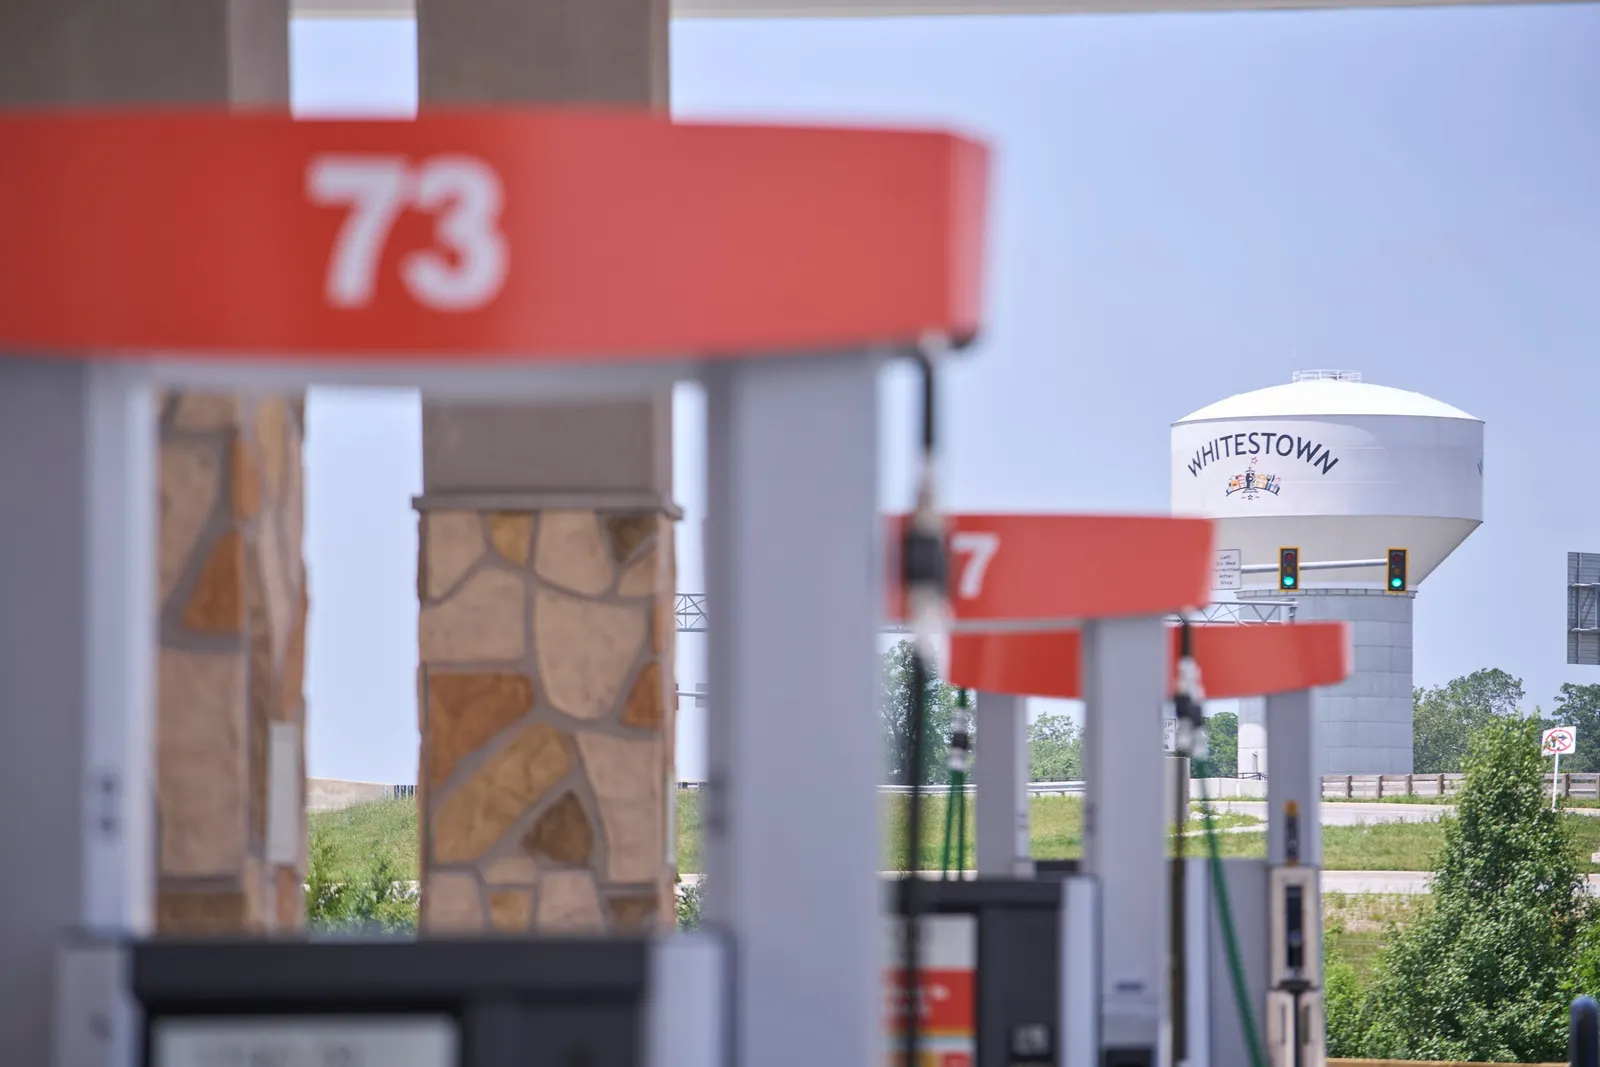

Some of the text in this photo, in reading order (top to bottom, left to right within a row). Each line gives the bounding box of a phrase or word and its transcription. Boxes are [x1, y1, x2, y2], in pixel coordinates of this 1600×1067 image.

[307, 153, 511, 310] 73
[1187, 431, 1339, 478] WHITESTOWN
[951, 531, 1000, 599] 7
